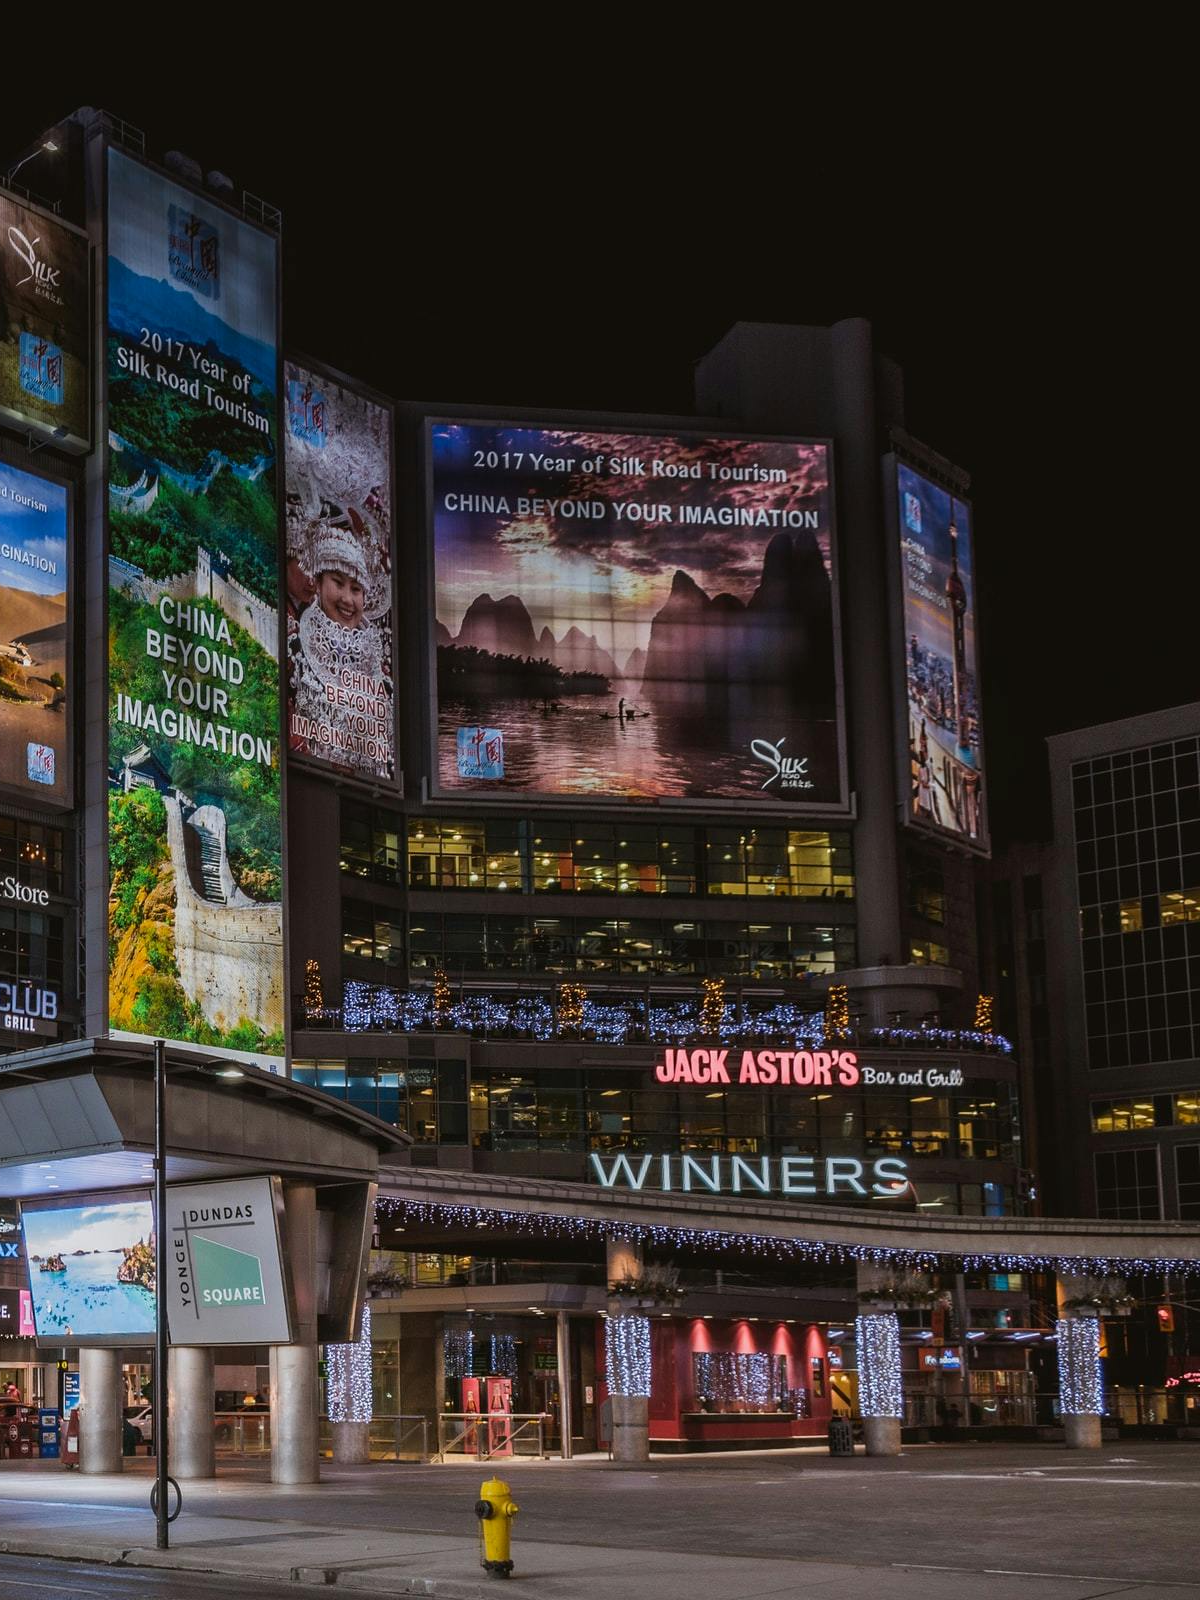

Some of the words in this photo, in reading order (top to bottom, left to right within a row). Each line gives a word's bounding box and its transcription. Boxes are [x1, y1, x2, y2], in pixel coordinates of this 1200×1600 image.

[140, 327, 184, 361] 2017
[189, 347, 228, 382] Year
[233, 374, 251, 395] of
[117, 346, 151, 379] Silk
[156, 363, 200, 400] Road
[204, 384, 269, 435] Tourism
[473, 450, 524, 471] 2017
[529, 453, 574, 473] Year
[581, 454, 602, 474] of
[609, 457, 646, 477] Silk
[652, 459, 701, 479] Road
[707, 462, 787, 483] Tourism
[11, 490, 48, 514] Tourism
[444, 492, 510, 515] CHINA
[517, 499, 606, 519] BEYOND
[612, 502, 672, 523] YOUR
[679, 505, 819, 529] IMAGINATION
[160, 595, 233, 647] CHINA
[146, 628, 244, 685] BEYOND
[162, 670, 229, 718] YOUR
[325, 683, 387, 720] BEYOND
[341, 668, 388, 700] CHINA
[117, 693, 272, 766] IMAGINATION
[292, 714, 388, 763] IMAGINATION
[346, 711, 387, 741] YOUR
[4, 876, 50, 906] Store
[4, 1014, 36, 1032] GRILL
[656, 1049, 731, 1084] JACK
[738, 1050, 860, 1086] ASTOR'S
[862, 1066, 895, 1086] Bar
[899, 1068, 923, 1085] and
[927, 1068, 964, 1088] Grill
[590, 1153, 910, 1196] WINNERS
[189, 1205, 254, 1223] DUNDAS
[175, 1238, 192, 1308] YONGE
[203, 1287, 261, 1303] SQUARE
